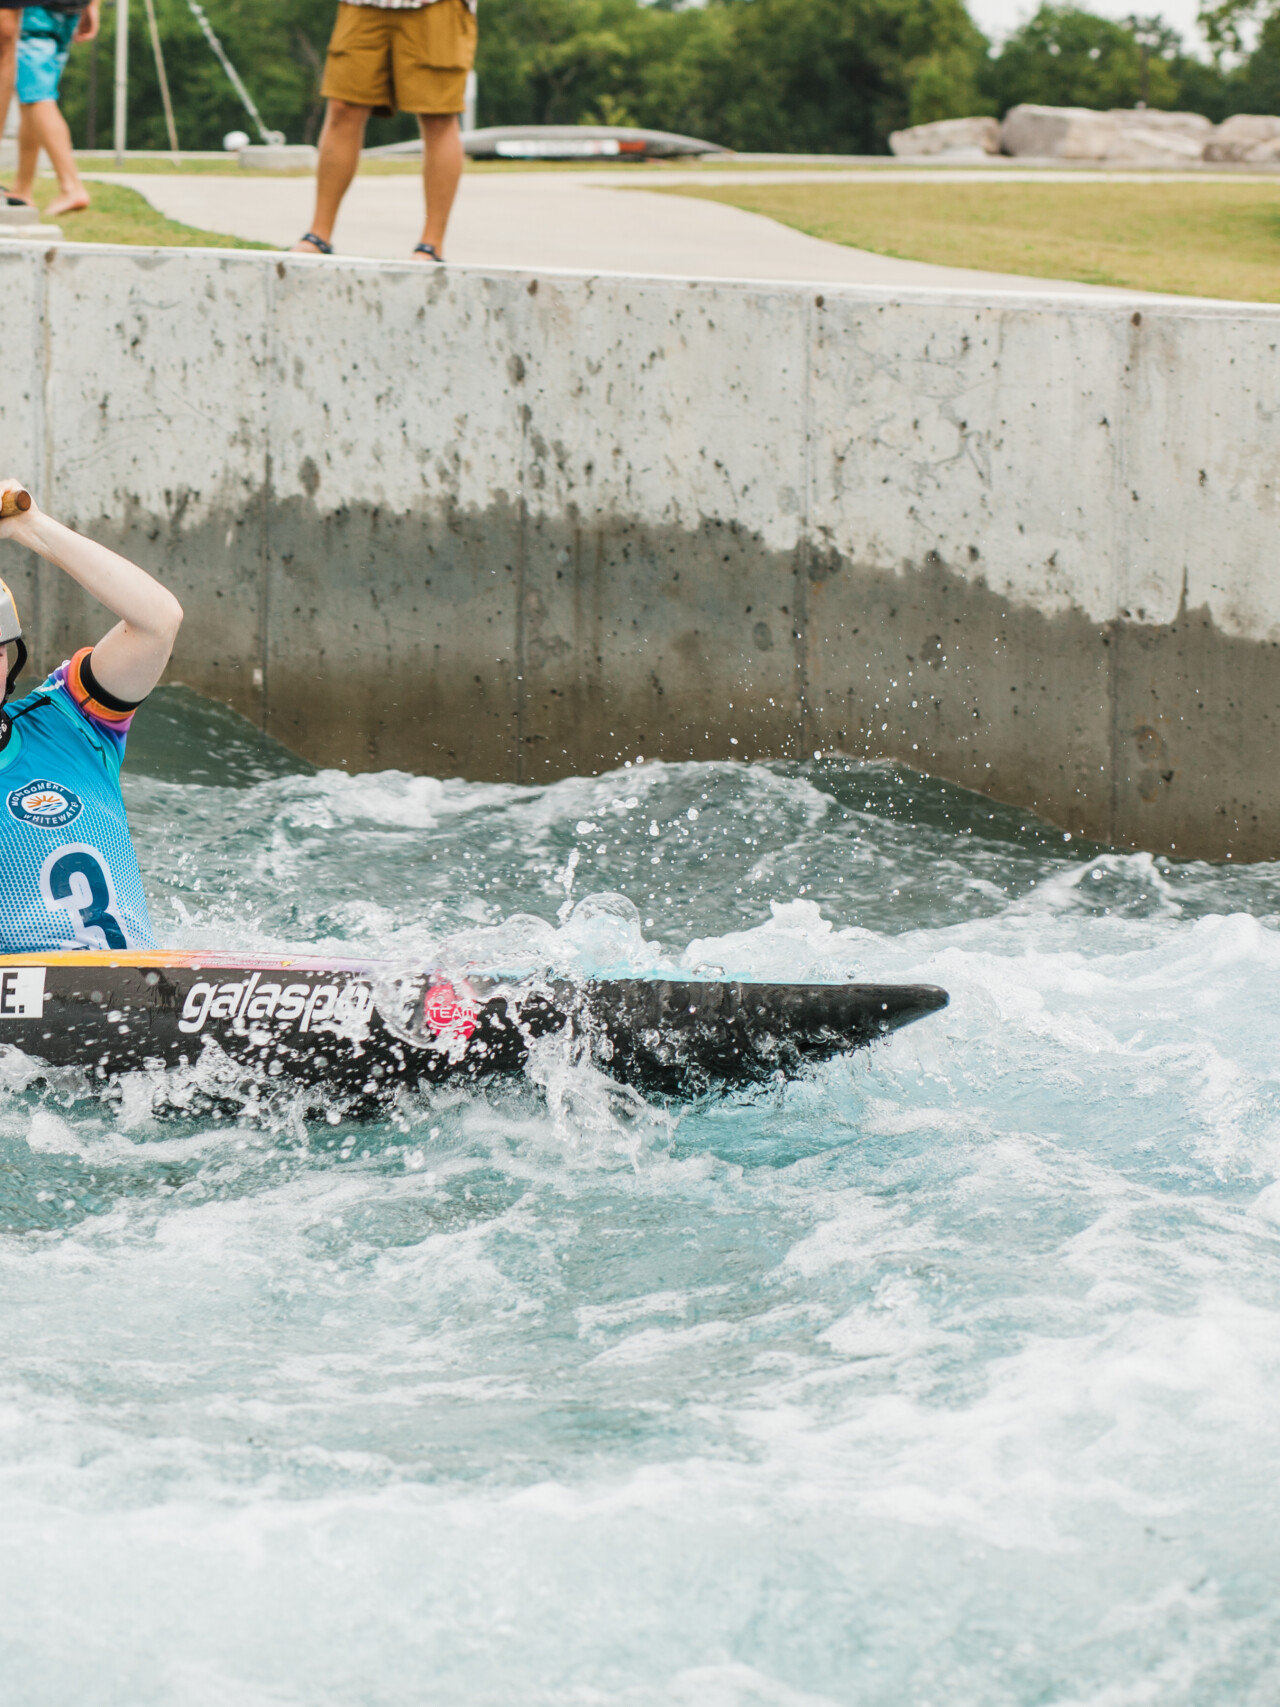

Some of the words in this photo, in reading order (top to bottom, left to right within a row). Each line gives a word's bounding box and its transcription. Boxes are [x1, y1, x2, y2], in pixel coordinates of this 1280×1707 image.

[49, 852, 127, 950] 3
[0, 972, 26, 1014] E.
[178, 972, 422, 1033] galaspot
[429, 1007, 474, 1019] TEAM
